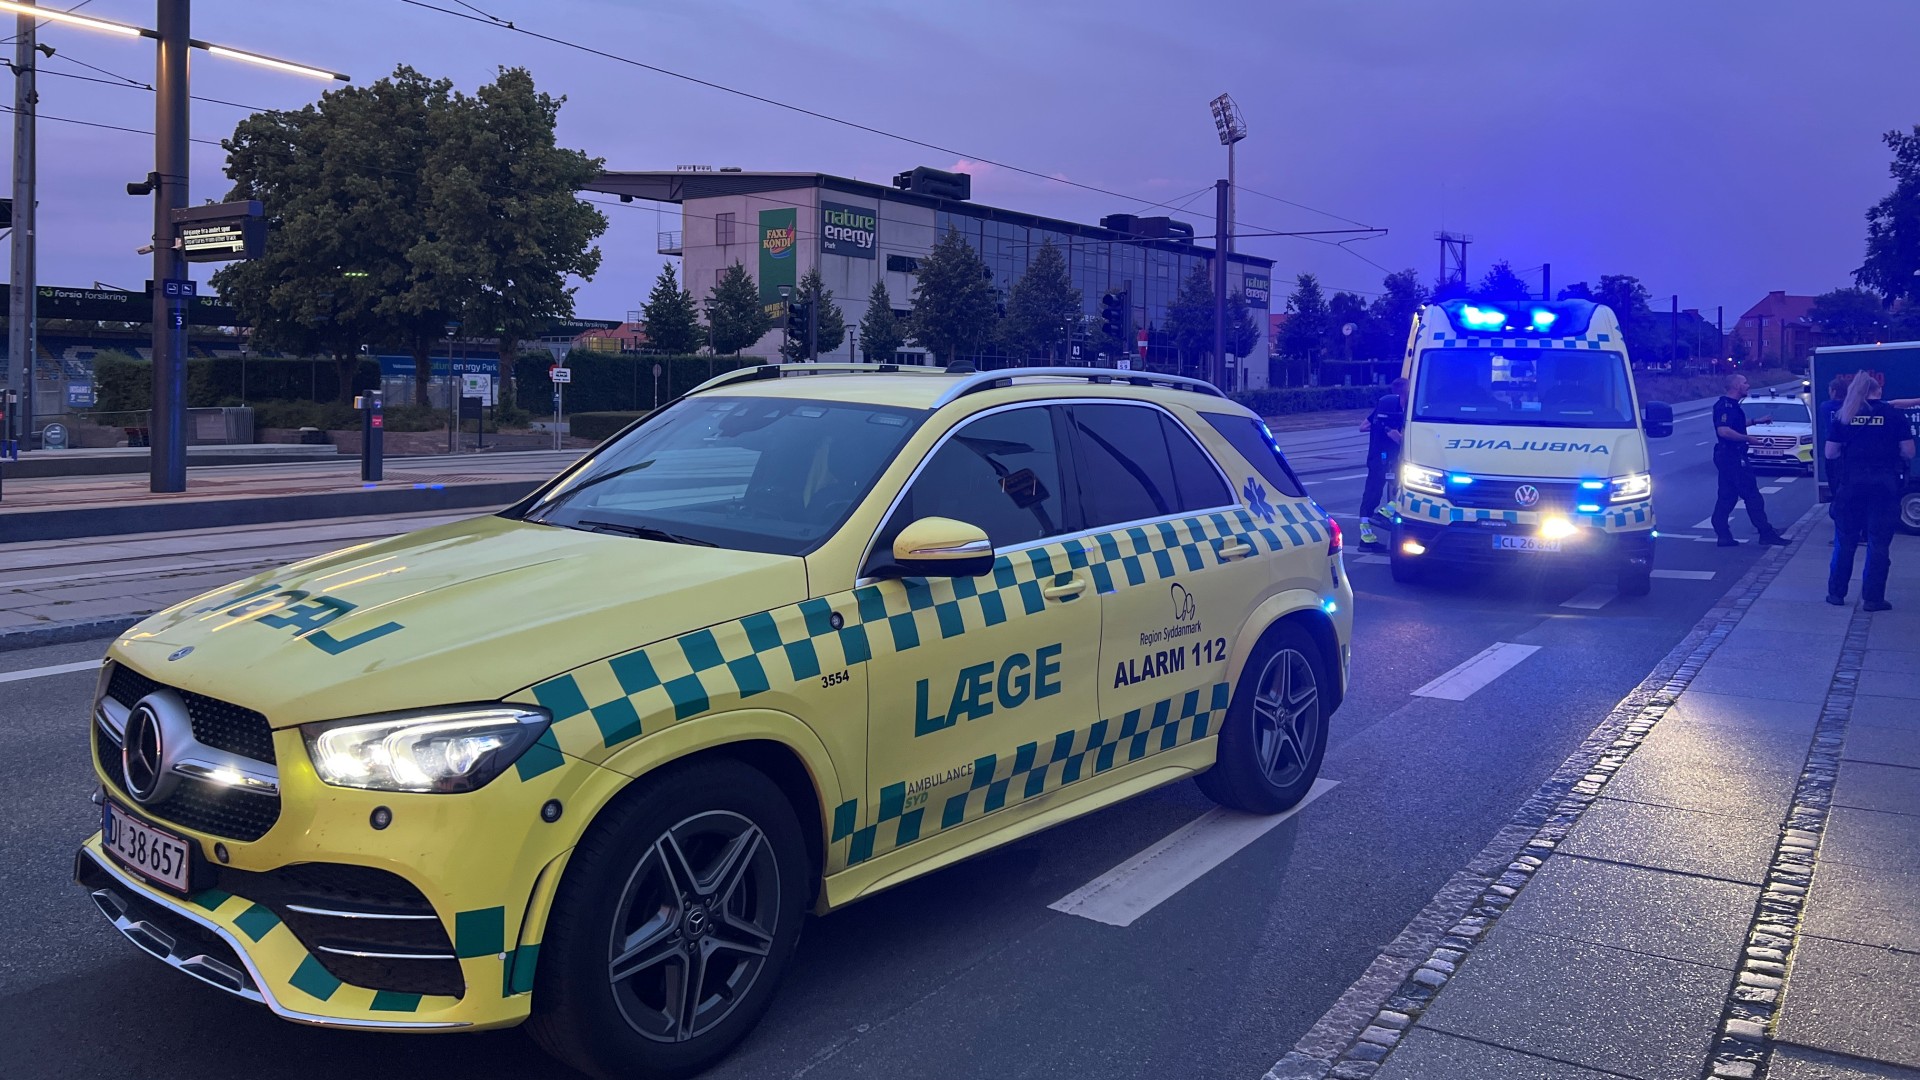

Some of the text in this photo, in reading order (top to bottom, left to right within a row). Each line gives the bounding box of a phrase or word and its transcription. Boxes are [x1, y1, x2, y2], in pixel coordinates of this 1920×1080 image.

[824, 208, 875, 231] nature
[766, 229, 787, 239] FAXE
[824, 225, 875, 249] energy
[763, 238, 791, 249] KONDI
[824, 241, 836, 250] Park
[54, 288, 128, 303] forsia forsikring
[176, 316, 183, 326] 3
[482, 363, 498, 371] Park
[1502, 537, 1517, 548] CL
[1520, 538, 1535, 549] 26
[1140, 620, 1202, 647] Region Syddanmark
[1113, 637, 1226, 689] ALARM 112
[821, 670, 850, 689] 3554
[914, 643, 1062, 738] LÆGE
[907, 763, 974, 796] AMBULANCE
[905, 791, 929, 809] SYD
[110, 813, 125, 853] DL
[128, 826, 146, 865] 38
[151, 837, 184, 880] 657
